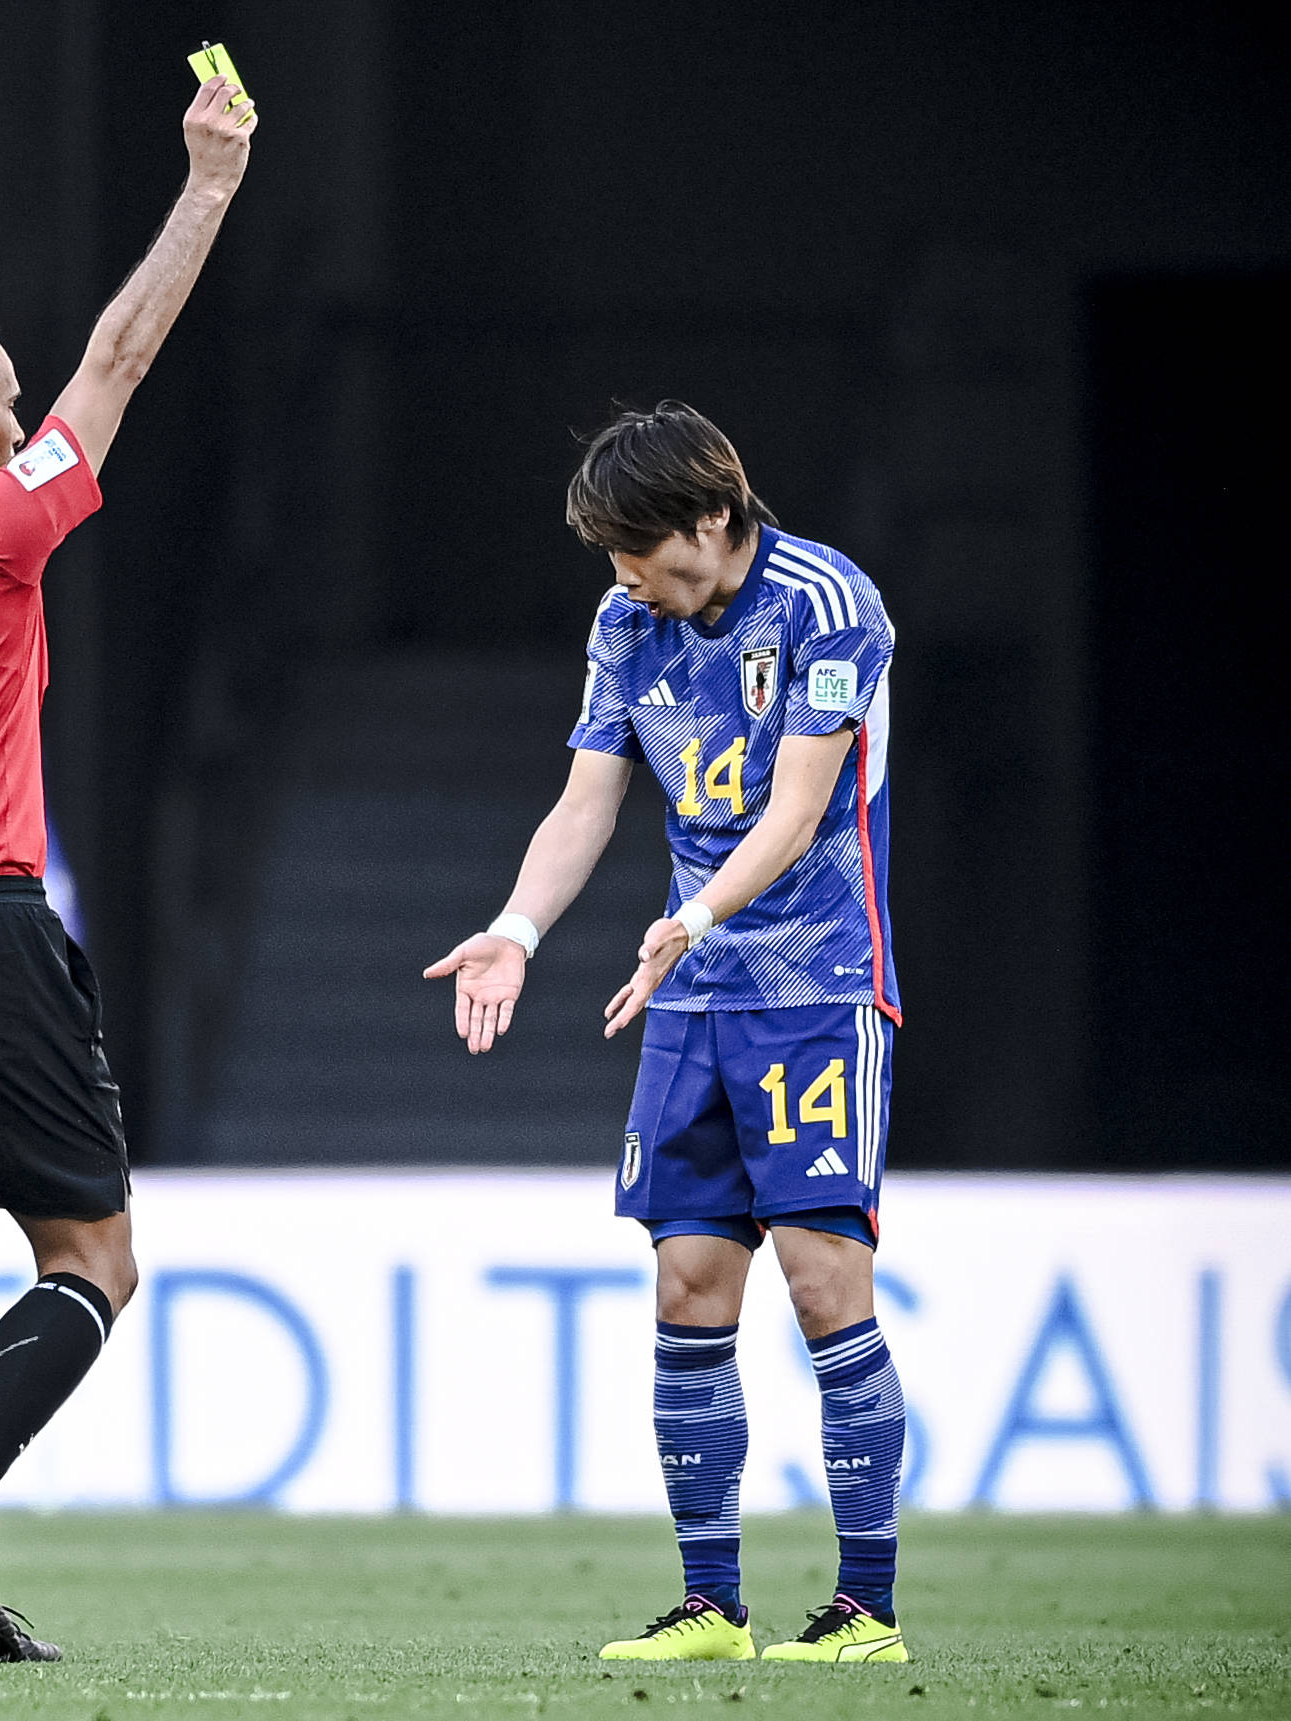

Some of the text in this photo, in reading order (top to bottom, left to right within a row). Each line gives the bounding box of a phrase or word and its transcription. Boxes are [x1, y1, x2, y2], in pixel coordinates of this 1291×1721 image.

[815, 677, 849, 691] LIVE
[816, 668, 837, 677] AFC
[676, 736, 746, 816] 14
[759, 1058, 846, 1144] 14
